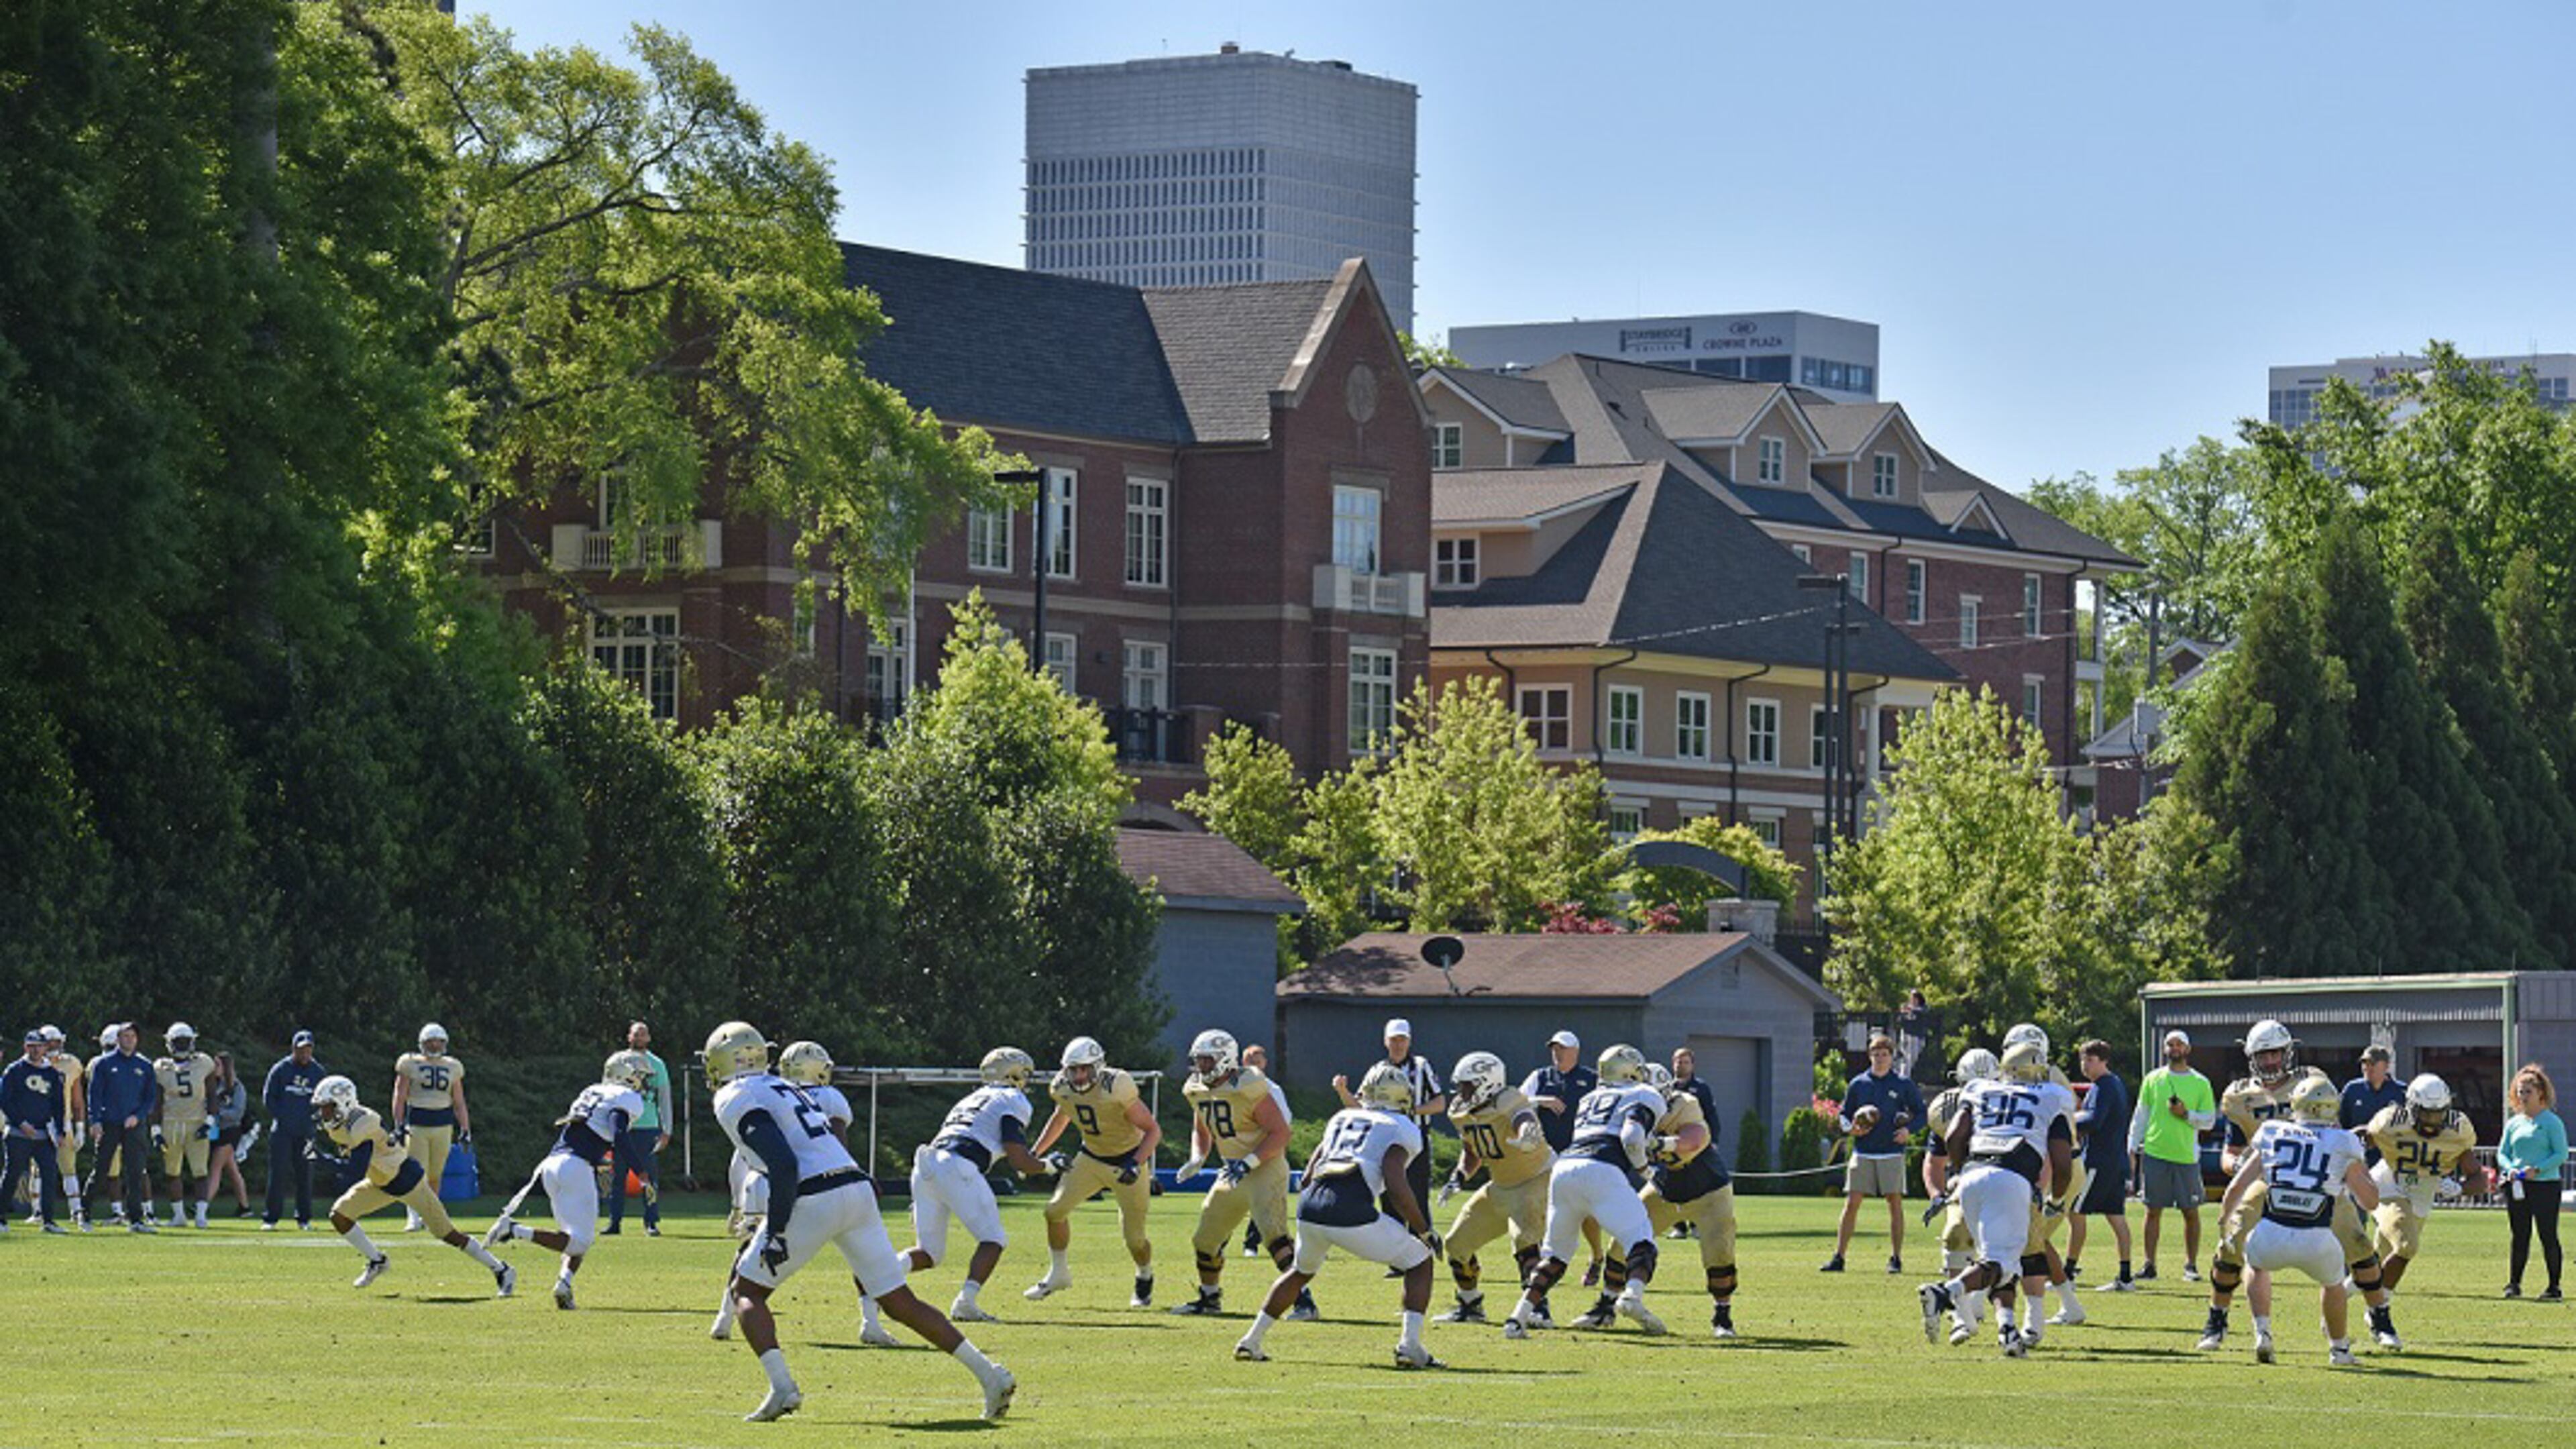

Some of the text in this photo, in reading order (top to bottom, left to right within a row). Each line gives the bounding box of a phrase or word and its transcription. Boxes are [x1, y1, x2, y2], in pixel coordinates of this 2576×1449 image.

[1703, 336, 1782, 350] CROWNE PLAZA
[176, 1070, 193, 1098] 5
[419, 1065, 449, 1091] 36
[1075, 1104, 1102, 1135] 9
[1198, 1099, 1236, 1140] 78
[1979, 1089, 2040, 1130] 96
[1463, 1124, 1504, 1160] 70
[2396, 1140, 2440, 1175] 24
[2271, 1139, 2331, 1191] 24
